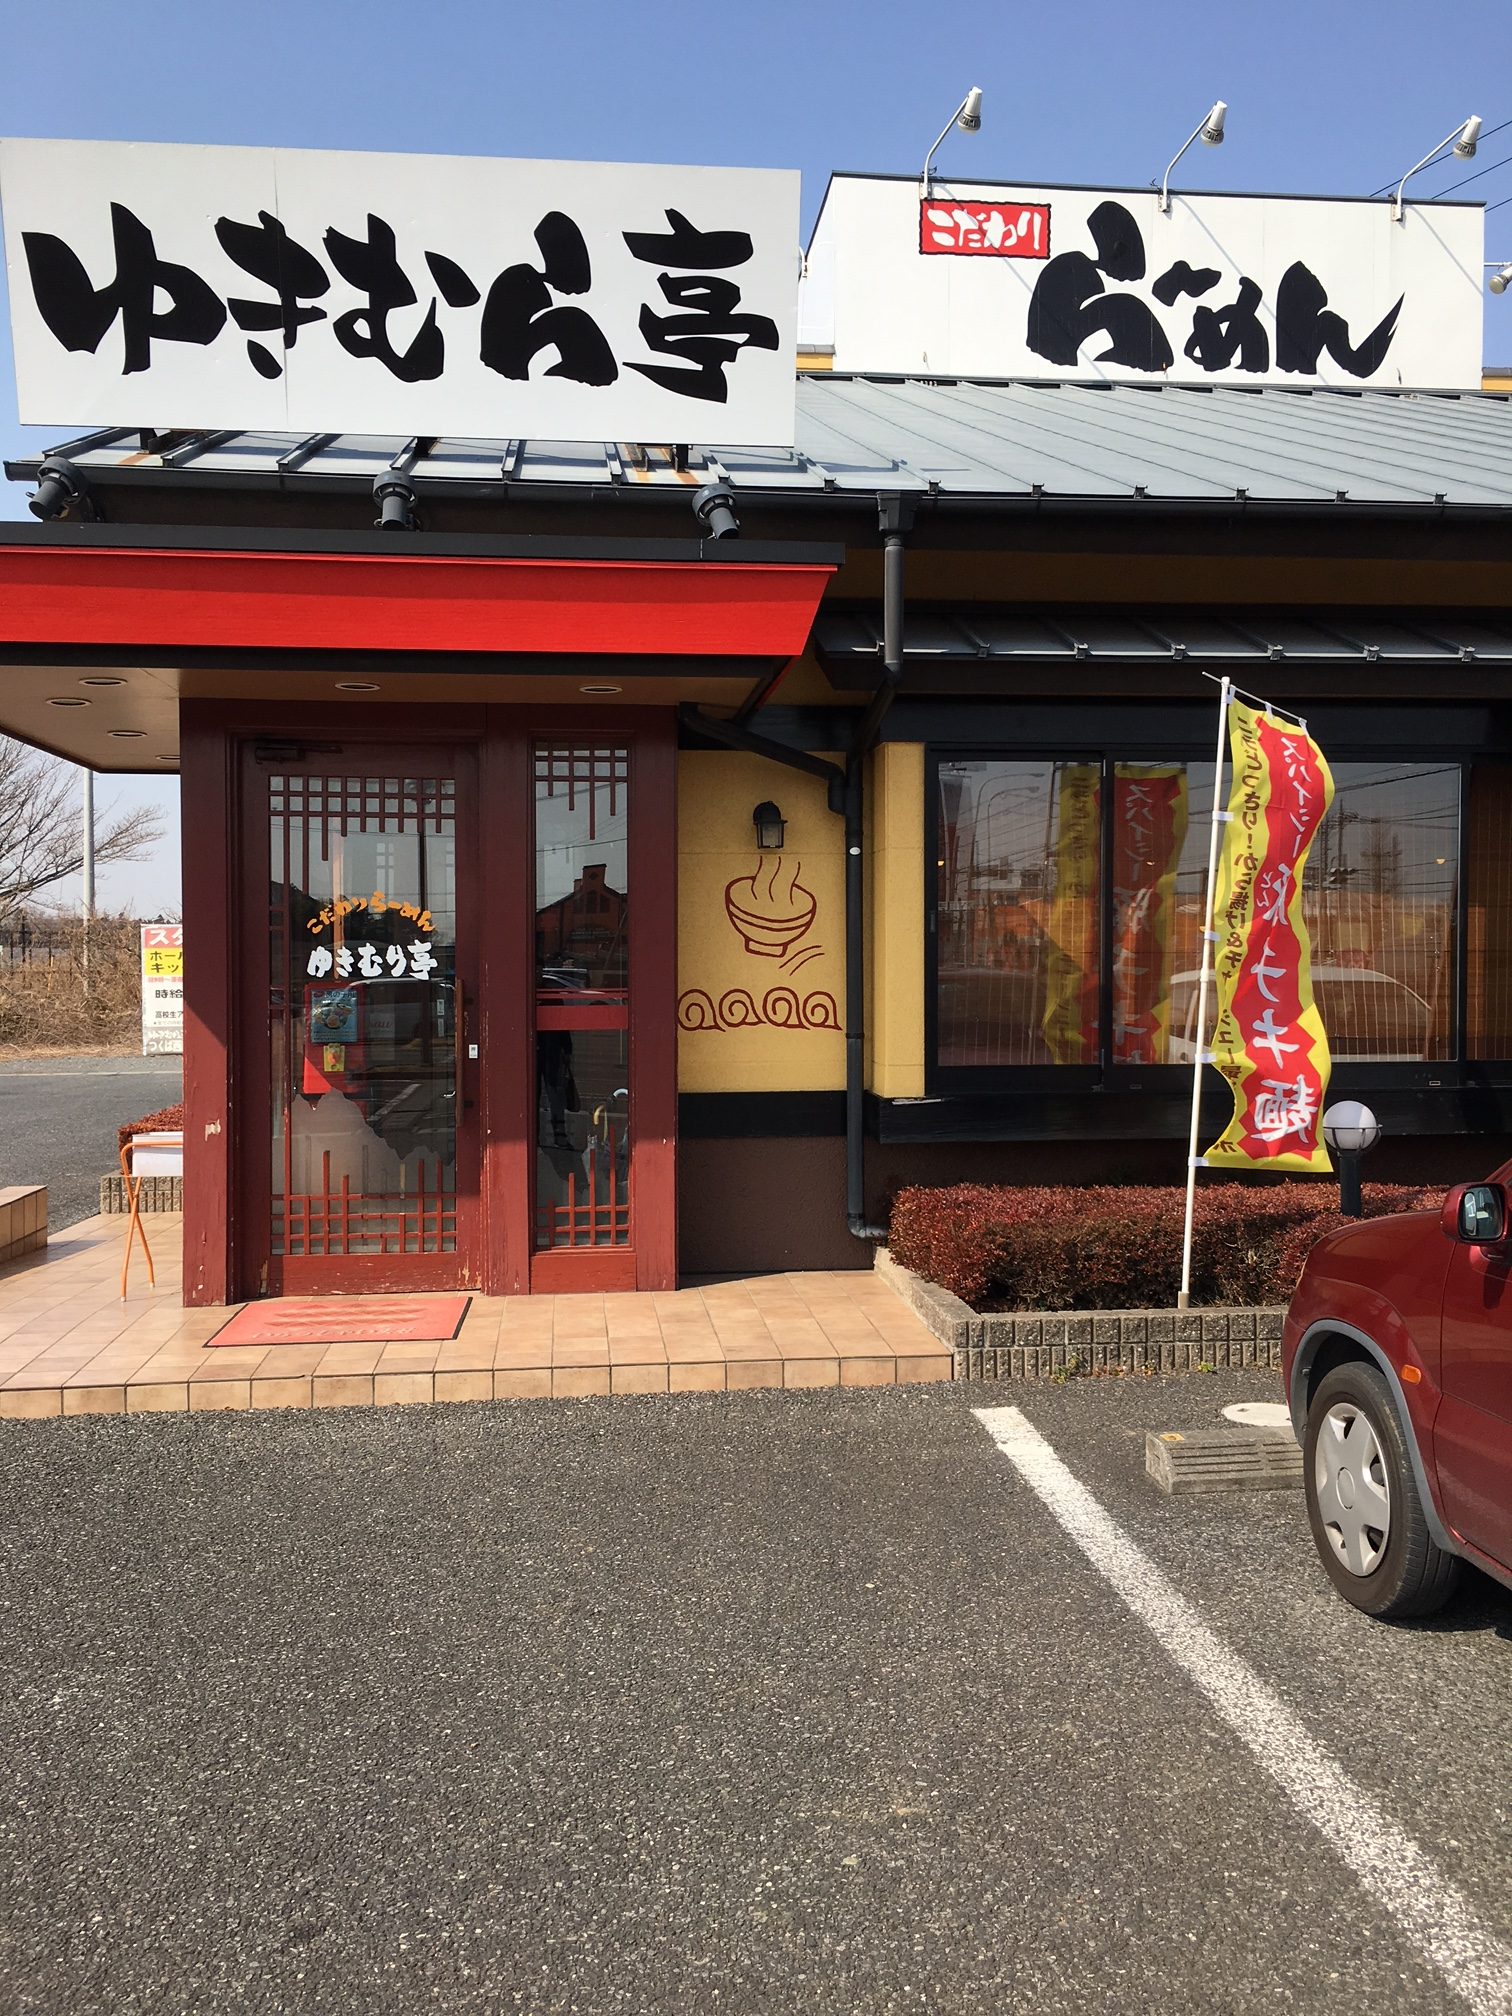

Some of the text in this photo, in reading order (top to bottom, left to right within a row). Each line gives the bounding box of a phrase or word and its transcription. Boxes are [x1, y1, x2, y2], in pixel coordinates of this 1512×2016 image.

[927, 208, 1041, 250] こだわり
[22, 201, 779, 403] ゆきむら亭
[1026, 200, 1405, 378] らーめん
[155, 988, 183, 999] 時給
